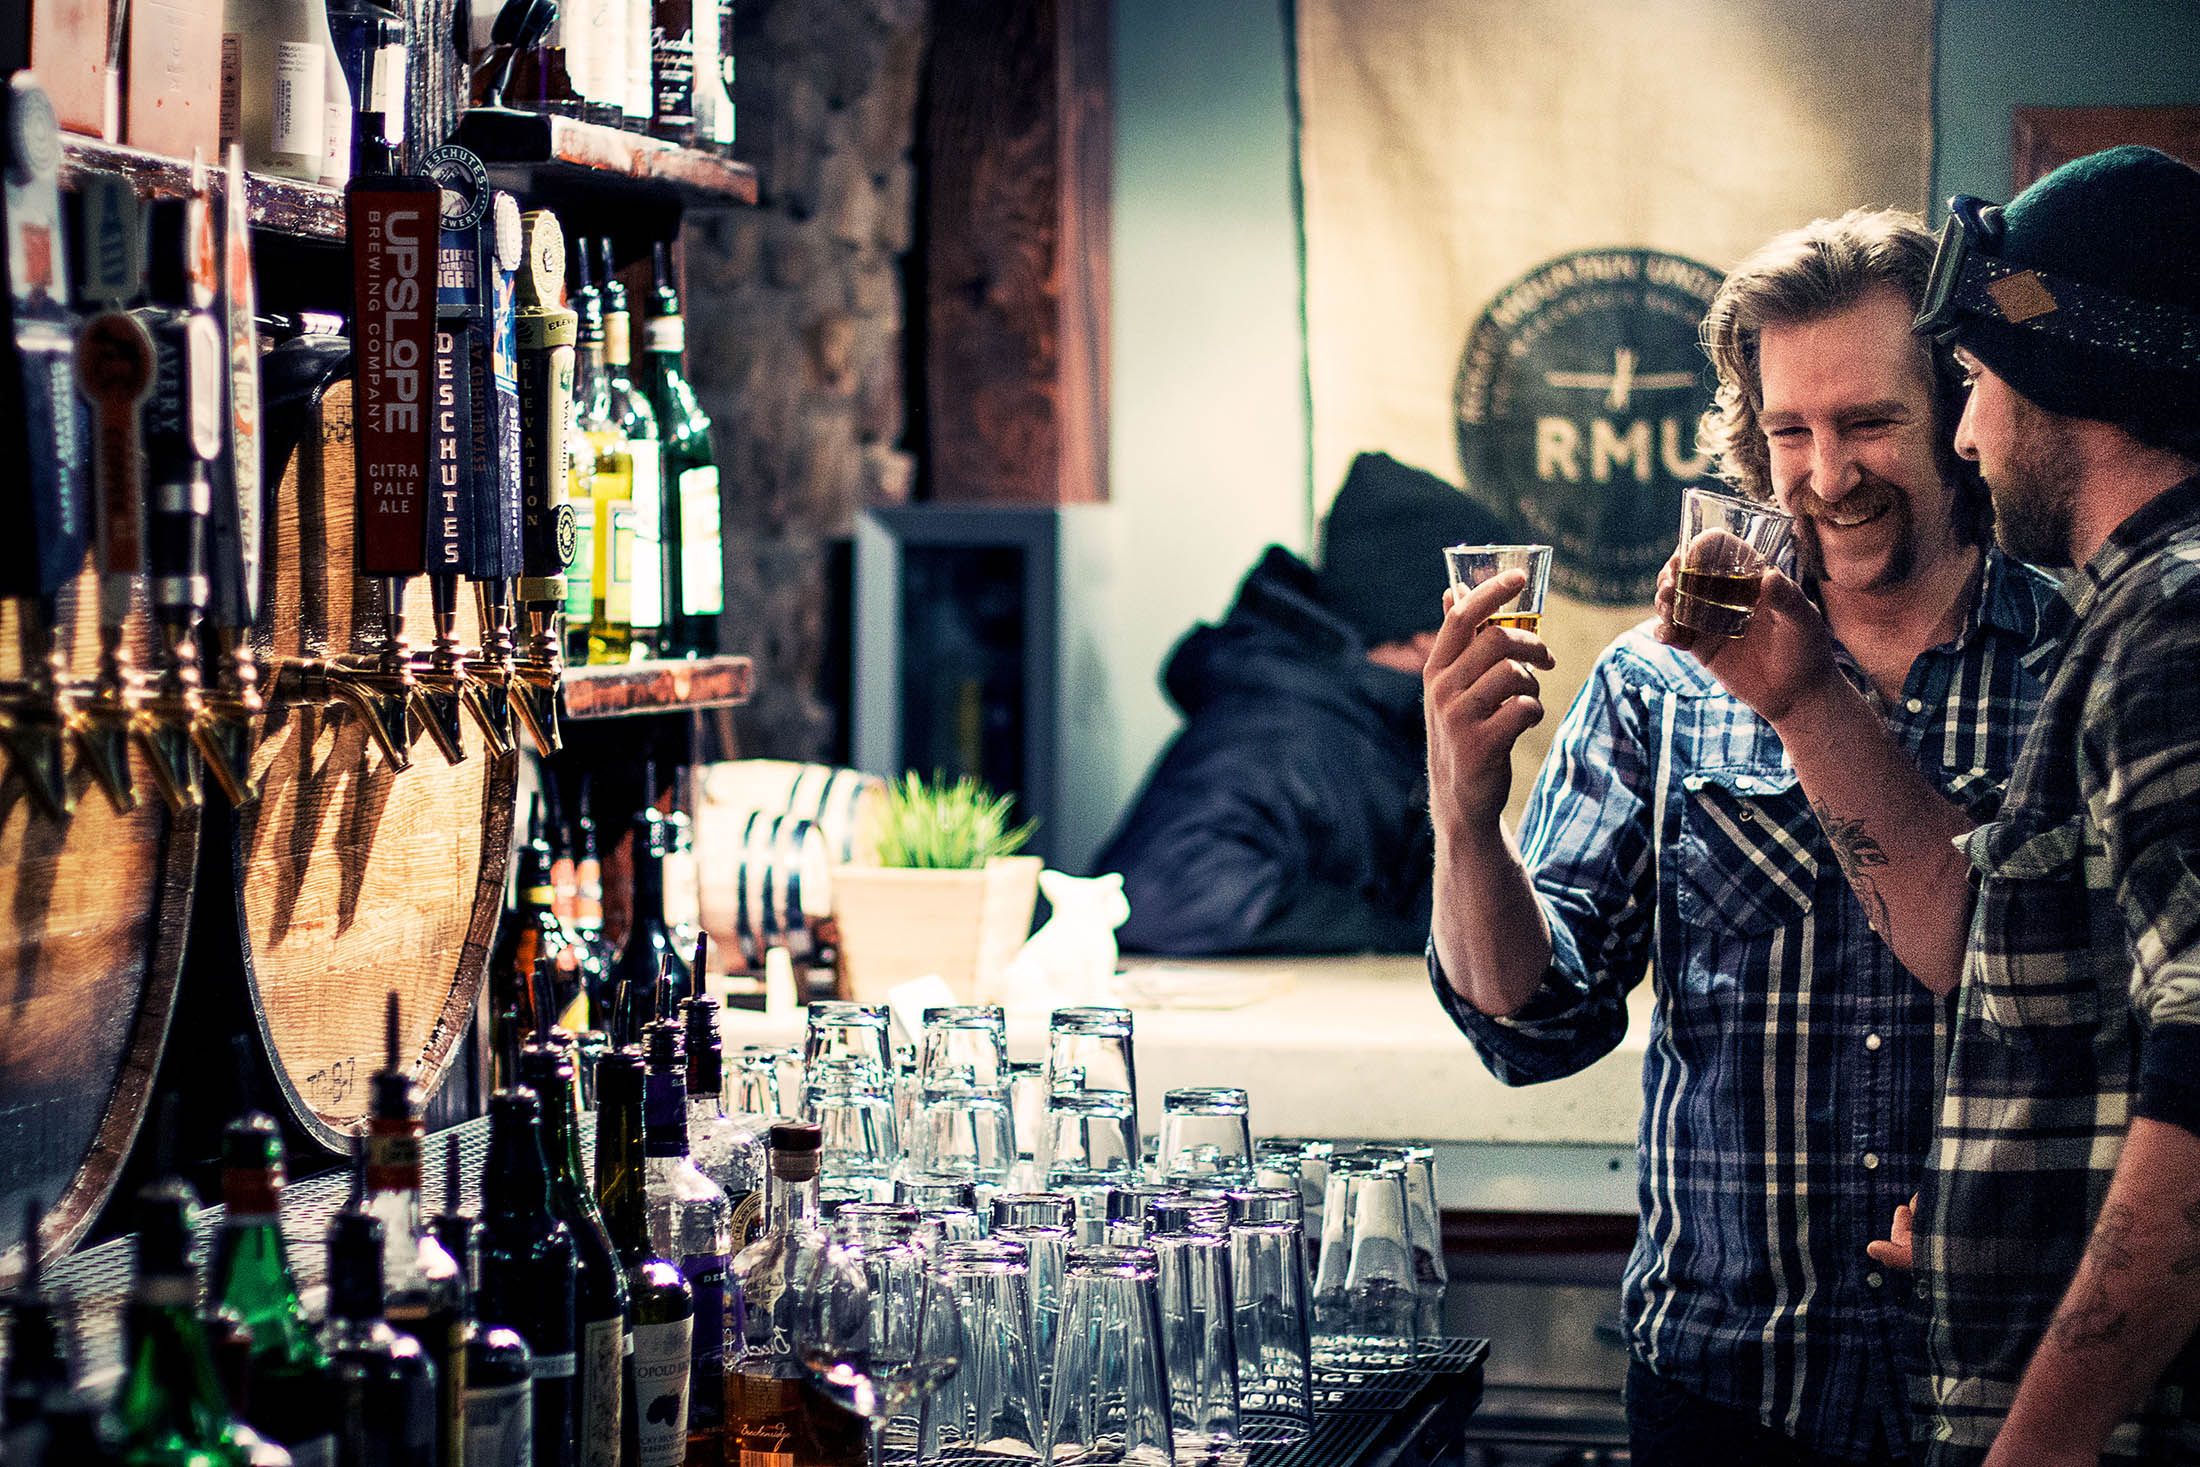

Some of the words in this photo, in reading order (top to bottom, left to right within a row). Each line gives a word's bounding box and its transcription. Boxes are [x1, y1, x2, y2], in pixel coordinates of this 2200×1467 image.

[421, 148, 486, 184] DESCHUTES
[439, 249, 475, 262] CIFIC
[441, 212, 478, 227] EWERY
[367, 210, 381, 313] BREWING
[384, 211, 419, 433] UPSLOPE
[160, 343, 181, 433] AVERY
[367, 323, 381, 433] COMPANY
[437, 333, 460, 564] DESCHUTES
[469, 365, 487, 472] ESTABLISHED
[521, 358, 540, 527] ELEVATION
[1535, 415, 1712, 483] RMU
[369, 463, 419, 478] CITRA
[373, 481, 415, 496] PALE
[379, 499, 410, 514] ALE
